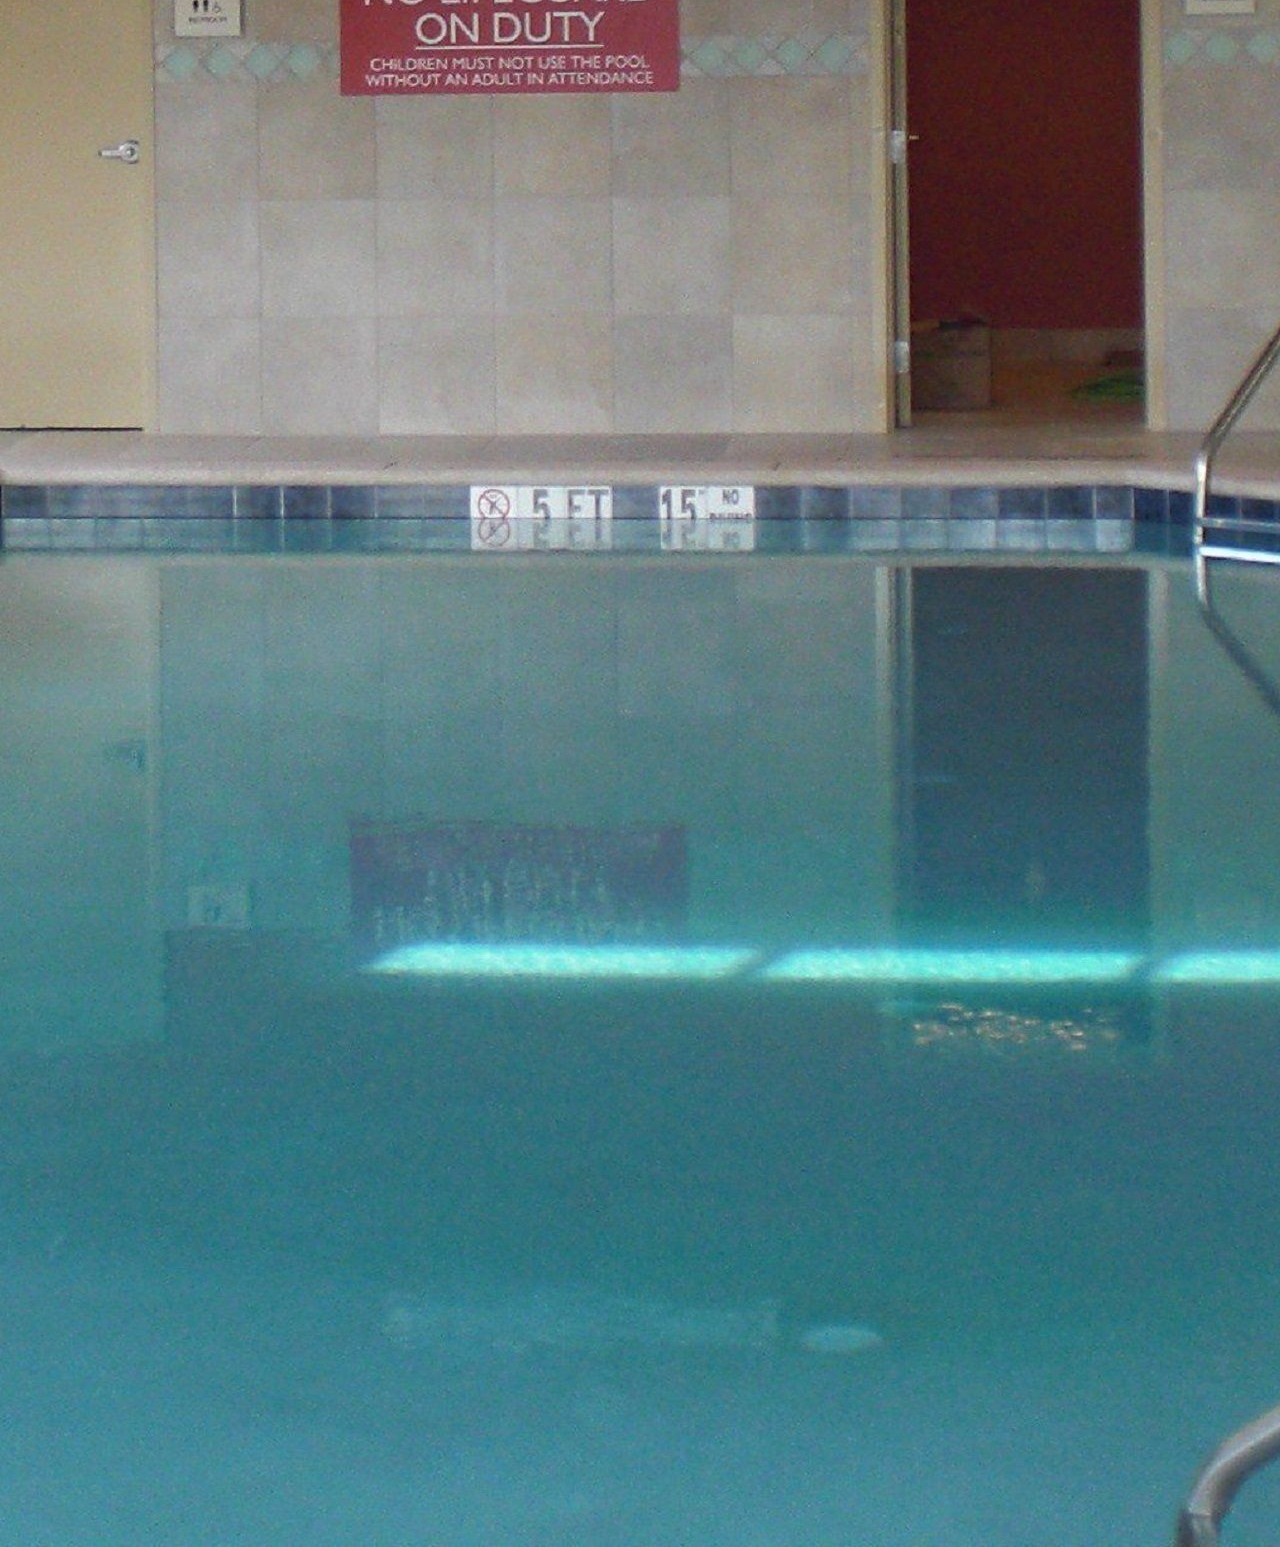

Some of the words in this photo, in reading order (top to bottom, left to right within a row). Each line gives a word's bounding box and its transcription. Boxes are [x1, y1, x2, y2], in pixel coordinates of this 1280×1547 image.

[415, 12, 479, 44] ON
[493, 11, 605, 43] DUTY
[370, 57, 448, 72] CHILDREN
[452, 56, 495, 71] MUST
[499, 56, 533, 70] NOT
[538, 55, 566, 69] USE
[570, 55, 601, 69] THE
[605, 54, 651, 69] POOL
[365, 73, 441, 88] WITHOUT
[445, 73, 468, 87] AN
[472, 72, 523, 87] ADULT
[527, 72, 544, 86] IN
[547, 70, 655, 86] ATTENDANCE
